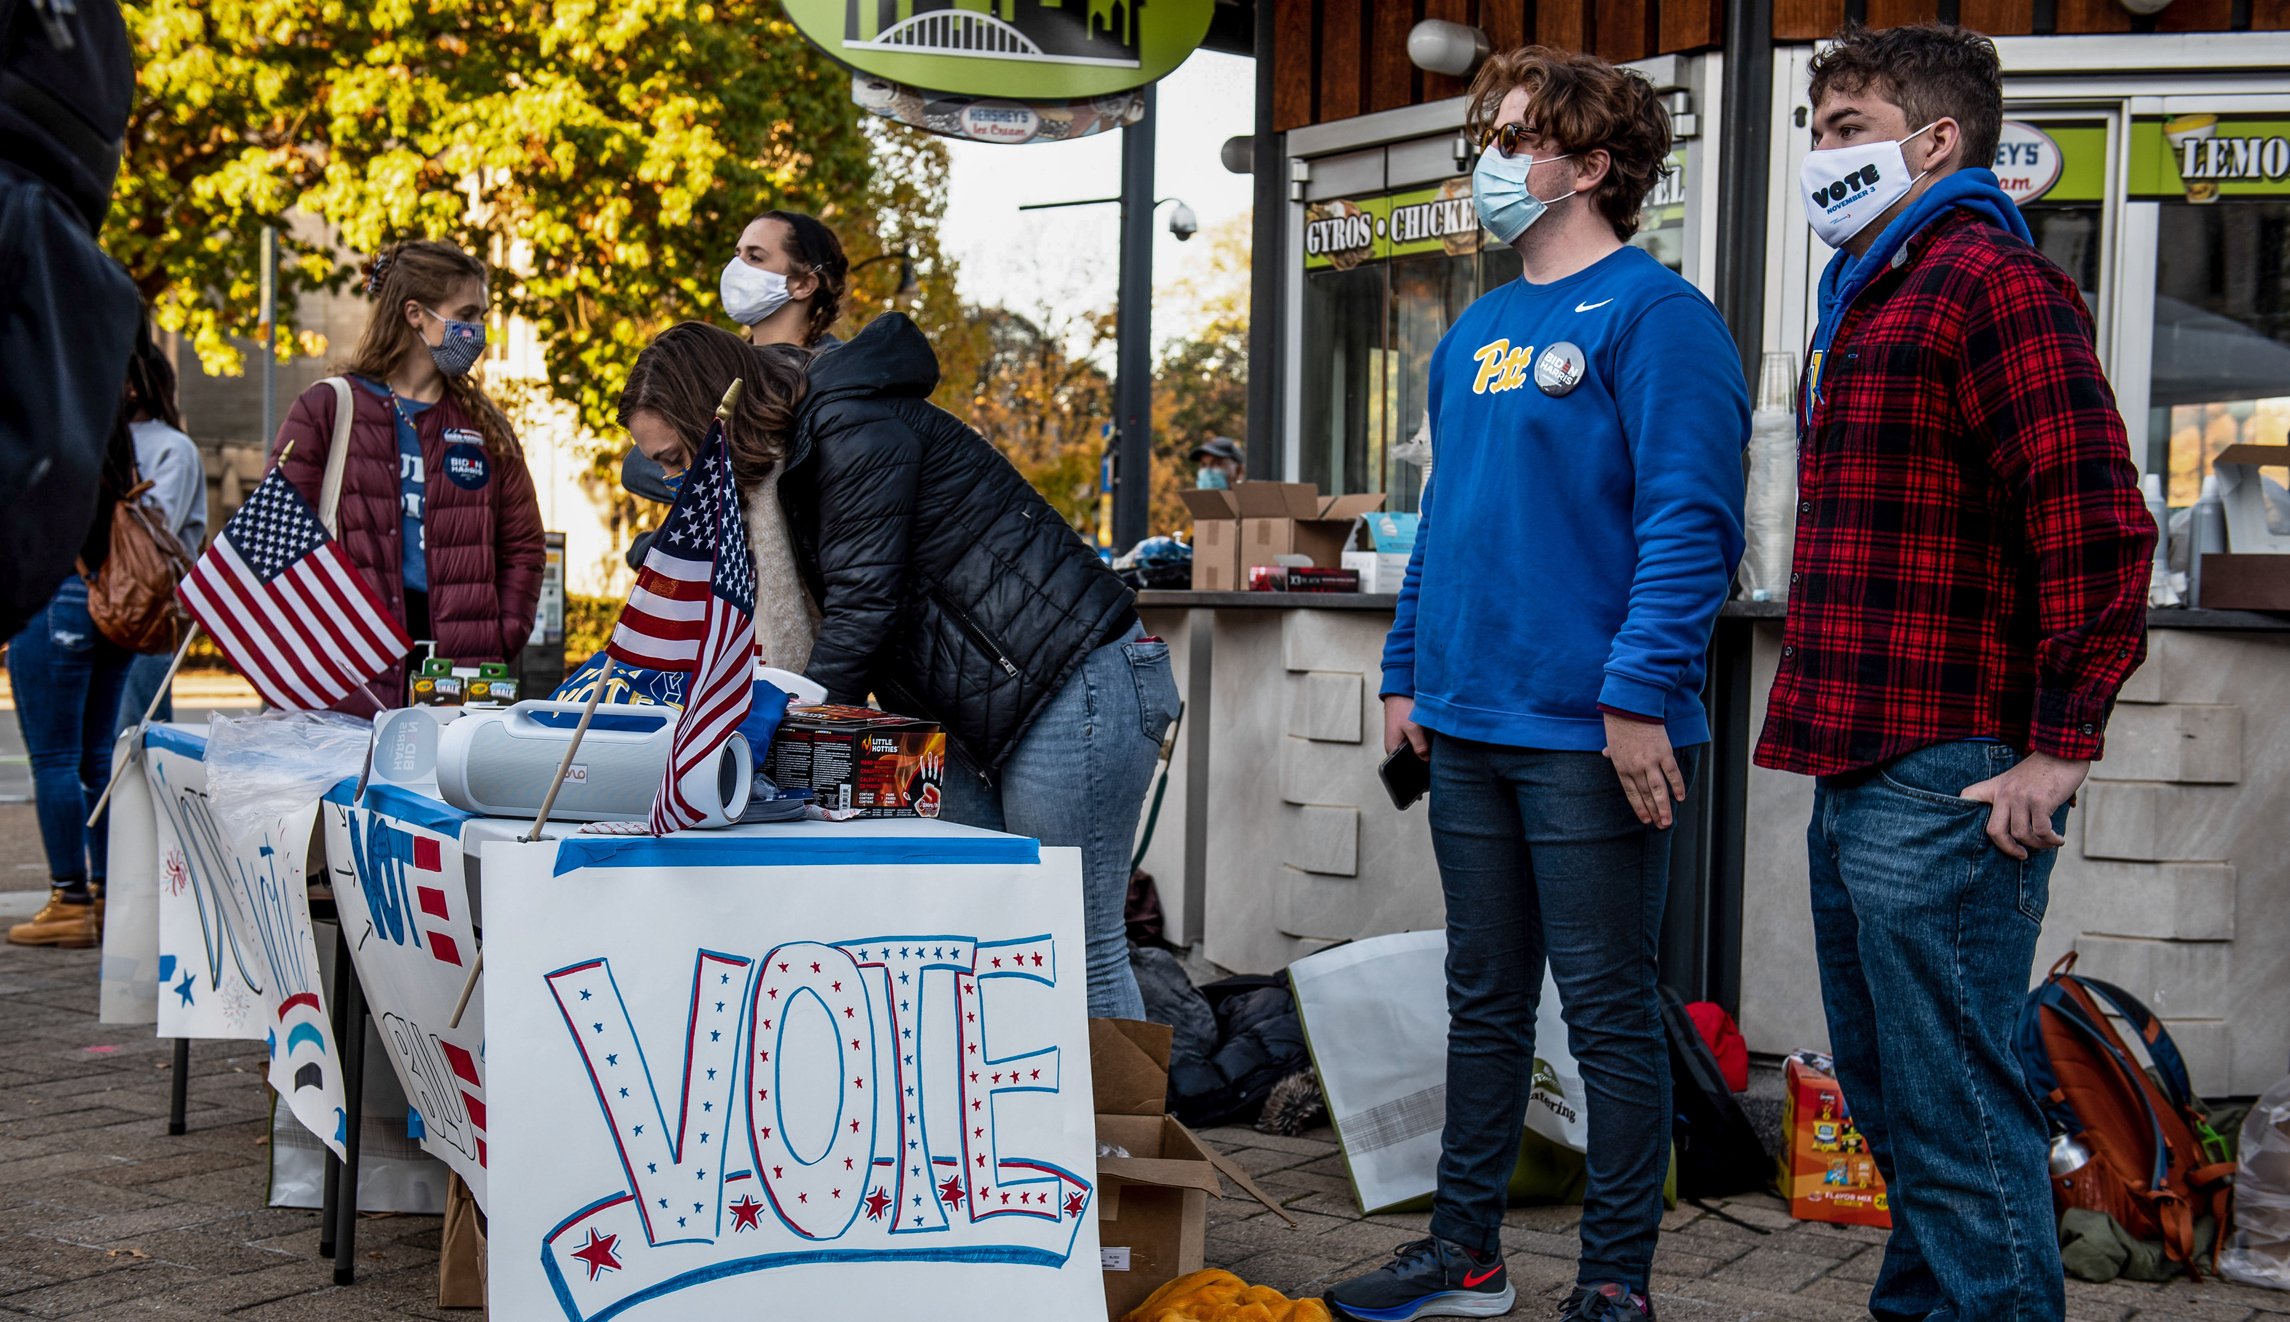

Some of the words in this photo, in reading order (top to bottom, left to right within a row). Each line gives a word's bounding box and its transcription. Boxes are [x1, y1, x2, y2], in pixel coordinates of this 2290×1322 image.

[970, 109, 1029, 123] HERSHEY'S
[973, 123, 987, 134] Ice
[990, 124, 1026, 136] Cream
[2181, 137, 2290, 178] LEMO
[1812, 163, 1880, 209] VOTE
[1827, 190, 1869, 215] NOVEMBER
[1306, 213, 1373, 255] GYROS
[1540, 361, 1573, 386] HARRIS
[1543, 352, 1579, 379] BIDEN
[872, 738, 893, 746] LITTLE
[872, 745, 897, 753] HOTTIES
[544, 932, 1062, 1247] VOTE
[1529, 1091, 1576, 1124] atering
[1825, 1191, 1856, 1202] FLAVOR
[1857, 1194, 1873, 1204] MIX
